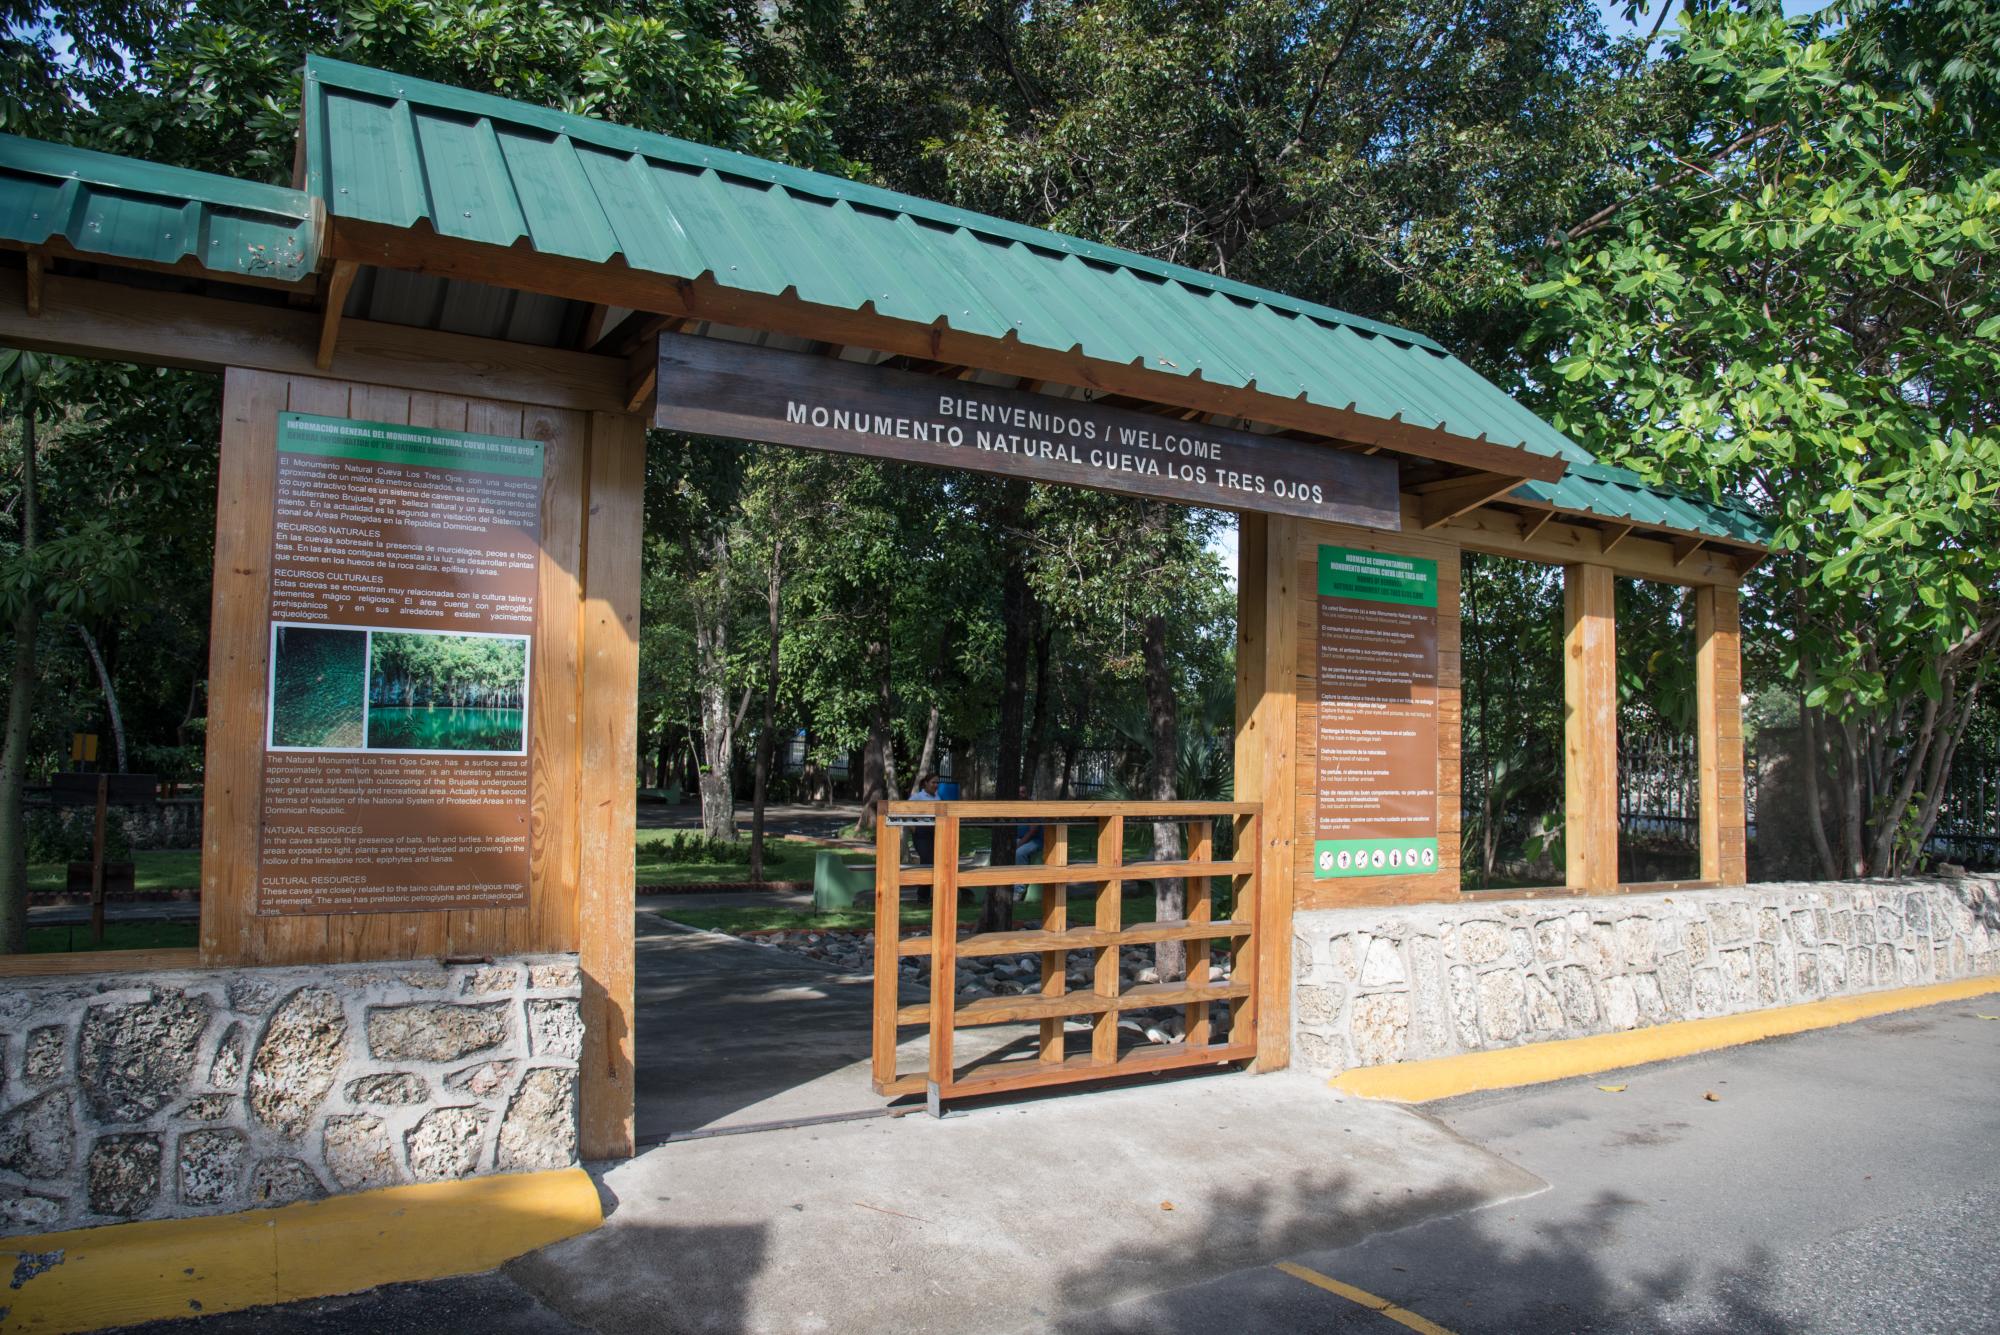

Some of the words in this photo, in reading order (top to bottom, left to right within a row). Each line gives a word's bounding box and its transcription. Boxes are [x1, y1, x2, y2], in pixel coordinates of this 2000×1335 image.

[940, 397, 1095, 439] BIENVENIDOS
[1105, 426, 1110, 441] /
[1120, 428, 1220, 460] WELCOME
[787, 402, 963, 447] MONUMENTO
[977, 431, 1082, 464] NATURAL
[1091, 450, 1159, 476] CUEVA
[1169, 463, 1206, 484] LOS
[1216, 470, 1265, 493] TRES
[1274, 480, 1322, 504] OJOS
[277, 507, 302, 516] cional
[303, 509, 313, 517] de
[395, 517, 403, 525] la
[277, 522, 327, 533] RECURSOS
[329, 527, 381, 537] NATURALES
[276, 532, 288, 540] En
[290, 533, 302, 541] las
[305, 536, 333, 544] cuevas
[336, 537, 374, 547] sobresale
[376, 540, 384, 548] la
[386, 541, 423, 552] presencia
[425, 544, 435, 552] de
[486, 551, 508, 559] peces
[297, 544, 309, 552] En
[310, 545, 322, 553] las
[386, 551, 425, 562] expuestas
[433, 554, 440, 562] la
[509, 560, 534, 570] plantas
[274, 569, 325, 579] RECURSOS
[326, 572, 383, 583] CULTURALES
[274, 578, 297, 587] Estas
[342, 583, 386, 593] encuentran
[388, 588, 405, 596] muy
[407, 587, 455, 597] relacionadas
[481, 593, 506, 601] cultura
[273, 589, 315, 598] elementos
[404, 597, 413, 605] El
[419, 598, 437, 606] área
[444, 600, 469, 608] cuenta
[400, 606, 444, 616] alrededores
[454, 610, 481, 618] existen
[490, 612, 532, 623] yacimientos
[267, 755, 283, 763] The
[318, 756, 360, 764] Monument
[399, 758, 417, 766] Ojos
[266, 765, 322, 775] approximately
[453, 768, 492, 777] interesting
[326, 777, 355, 786] system
[376, 777, 421, 786] outcropping
[448, 778, 479, 787] Brujuela
[481, 778, 527, 787] underground
[265, 806, 308, 814] Dominican
[301, 856, 313, 864] the
[315, 856, 353, 864] limestone
[311, 876, 367, 884] RESOURCES
[262, 897, 274, 905] cal
[317, 896, 332, 904] The
[353, 895, 368, 903] has
[370, 894, 410, 904] prehistoric
